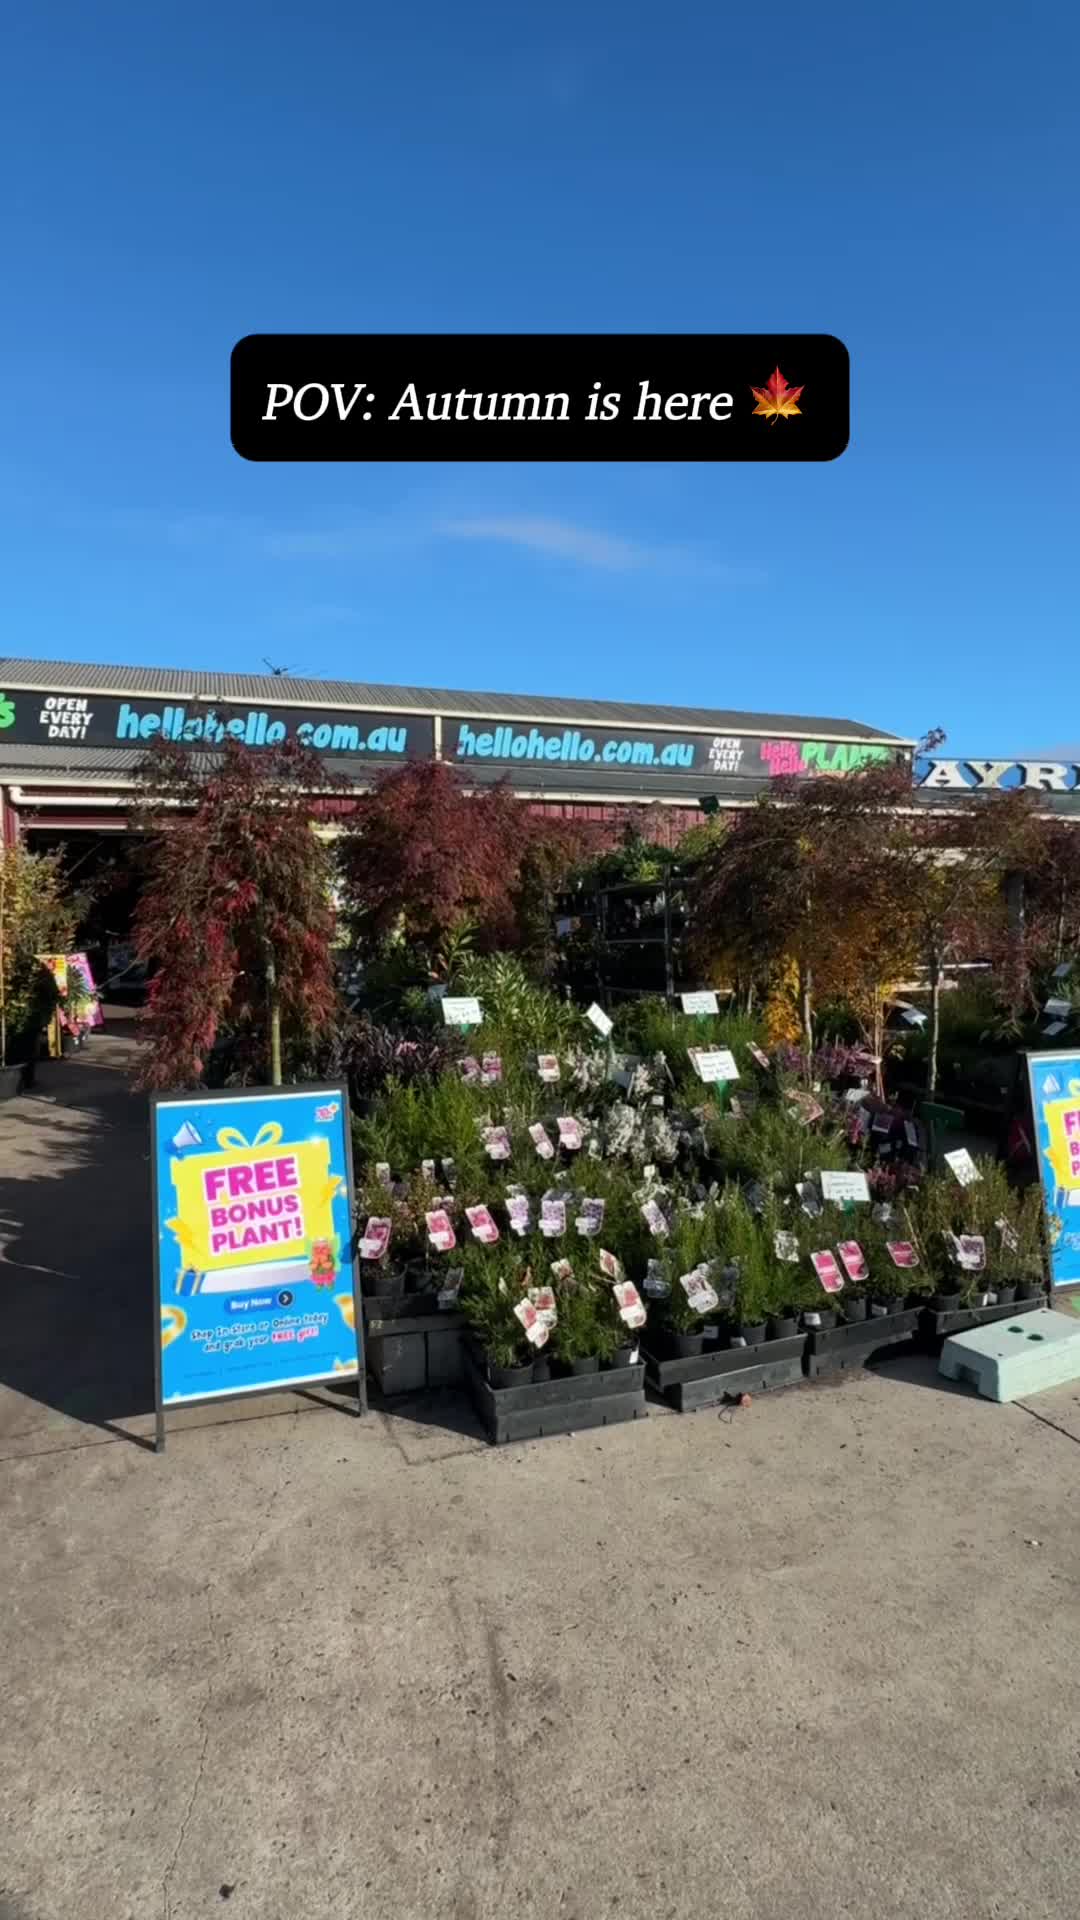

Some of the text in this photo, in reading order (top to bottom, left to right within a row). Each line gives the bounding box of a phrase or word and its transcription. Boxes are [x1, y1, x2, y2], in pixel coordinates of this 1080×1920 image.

[45, 697, 88, 711] OPEN
[40, 710, 94, 725] EVERY
[48, 725, 87, 739] DAY!
[457, 724, 694, 767] hellohello.com.au
[713, 737, 741, 748] OPEN
[708, 748, 744, 760] EVERY
[714, 759, 739, 772] DAY!
[920, 760, 1080, 791] AYR
[205, 1157, 297, 1201] FREE
[211, 1195, 298, 1227] BONUS
[212, 1216, 302, 1252] PLANT!
[231, 1298, 272, 1311] Buy Now
